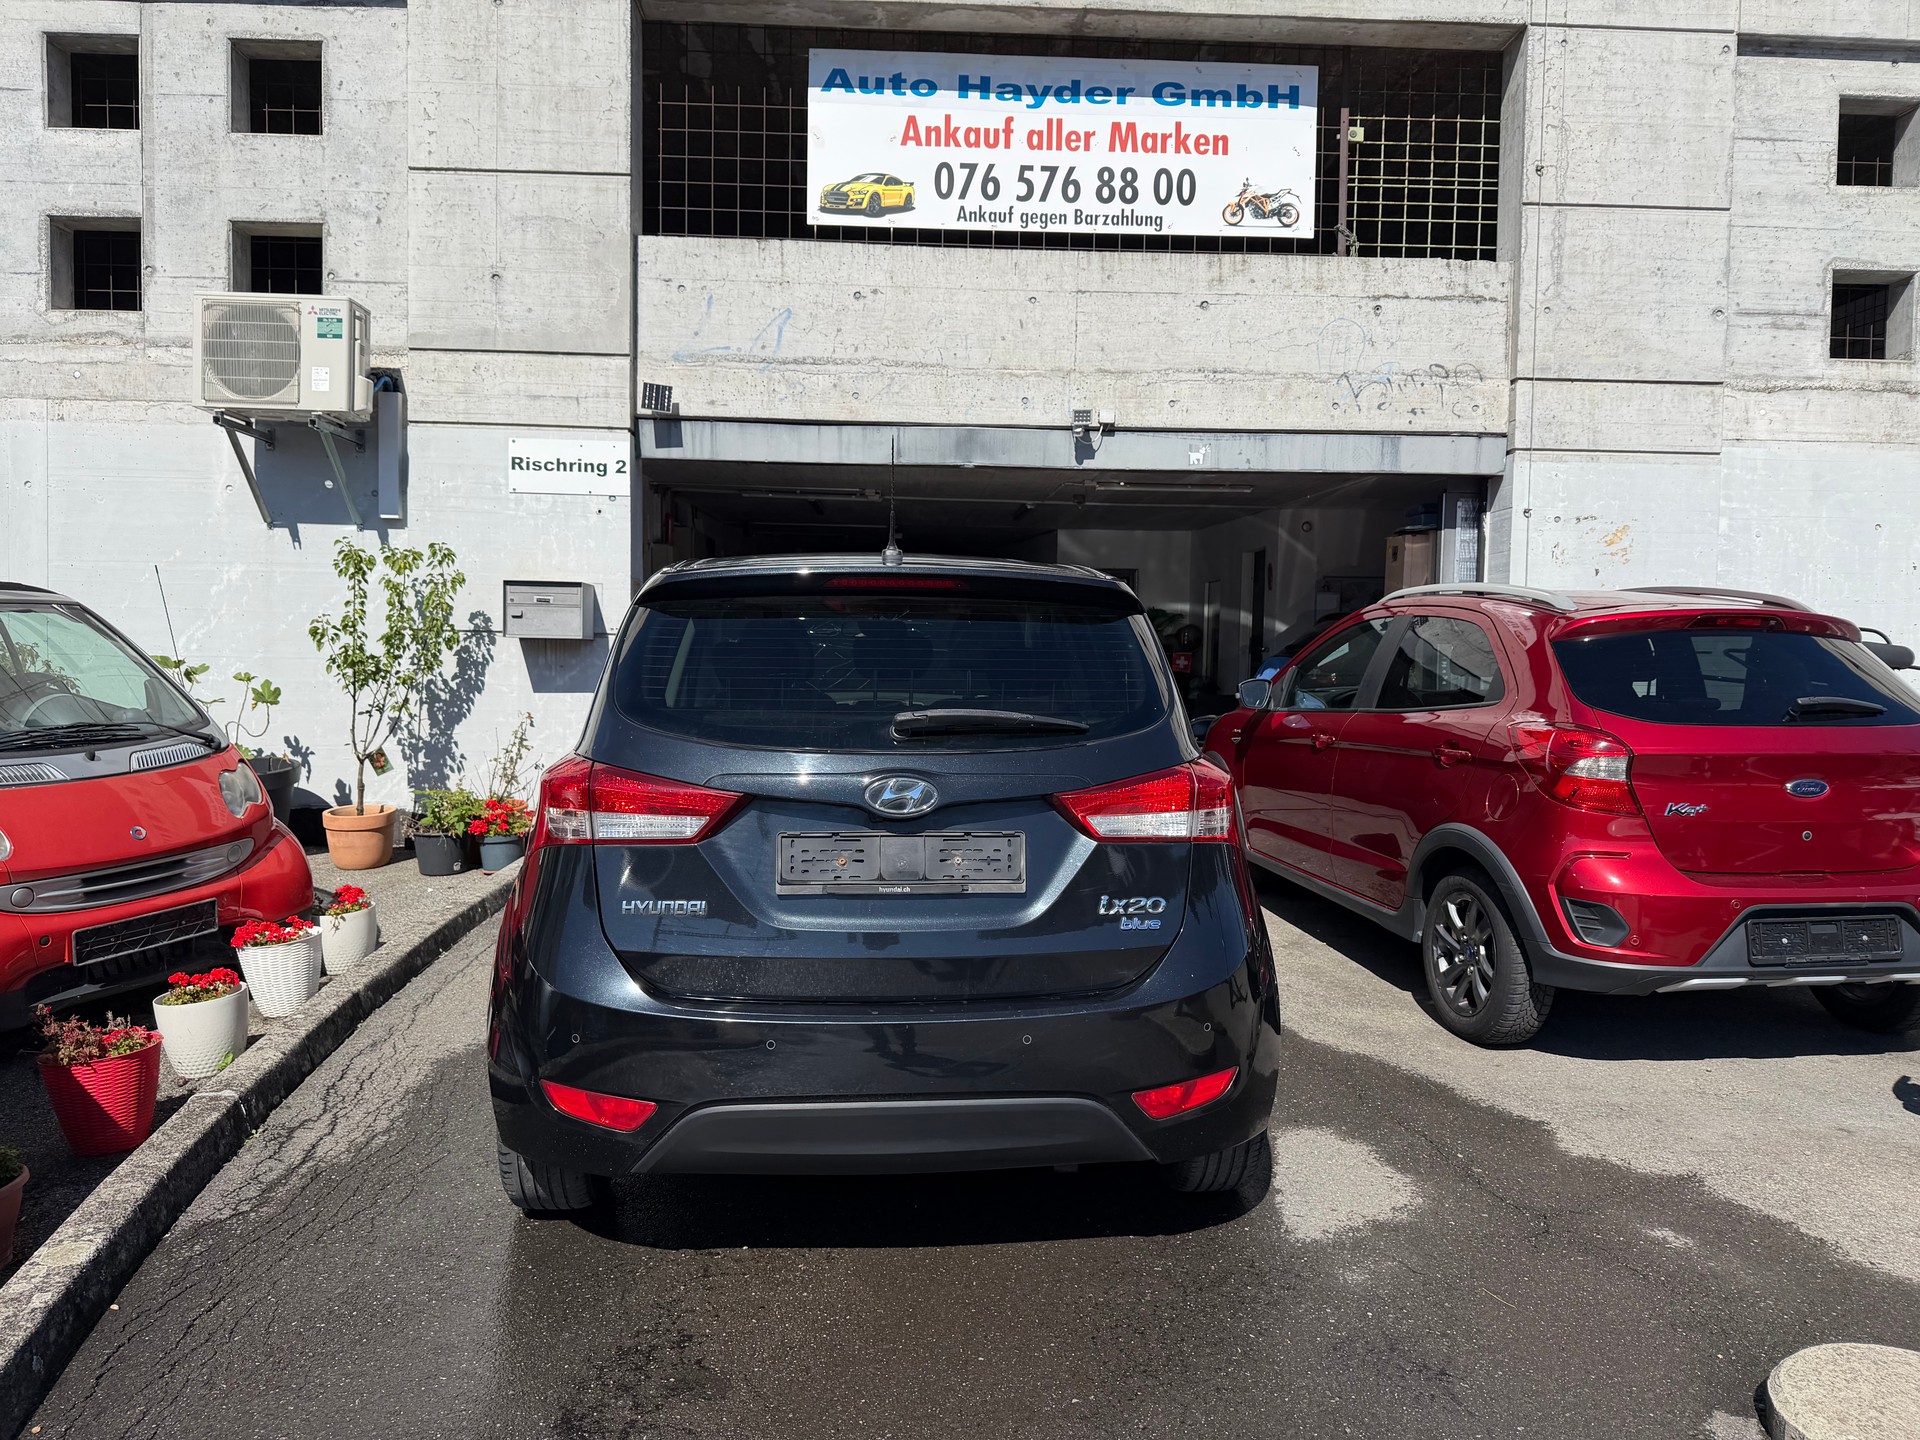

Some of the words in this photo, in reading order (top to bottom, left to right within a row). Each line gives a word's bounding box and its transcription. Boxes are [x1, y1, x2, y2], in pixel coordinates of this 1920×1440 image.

[820, 67, 938, 98] Auto
[957, 73, 1136, 110] Hayder
[1151, 81, 1300, 110] GmbH
[900, 113, 1015, 150] Ankauf
[1026, 117, 1096, 152] aller
[1108, 120, 1229, 156] Marken
[934, 161, 1001, 201] 076
[1015, 164, 1081, 204] 576
[1095, 166, 1139, 205] 88
[1153, 167, 1196, 206] 00
[956, 204, 1014, 224] Ankauf
[1020, 211, 1067, 230] gegen
[1074, 207, 1163, 232] Barzahlung
[511, 456, 607, 477] Rischring
[615, 459, 627, 474] 2
[621, 900, 707, 916] HYUNDAI
[1099, 895, 1167, 915] ix20
[1120, 917, 1161, 931] blue
